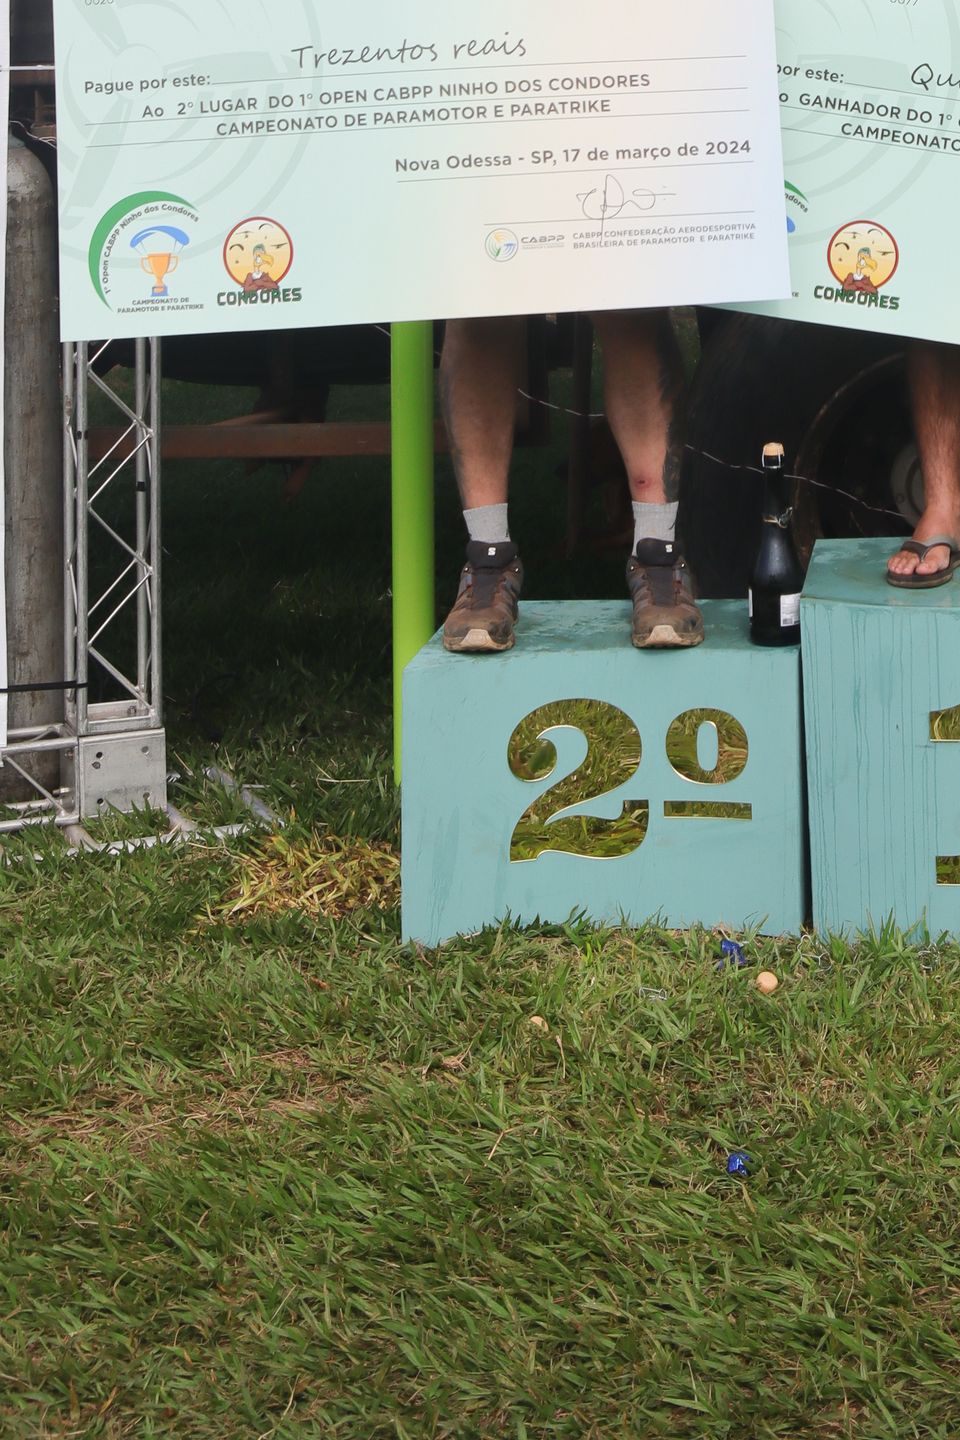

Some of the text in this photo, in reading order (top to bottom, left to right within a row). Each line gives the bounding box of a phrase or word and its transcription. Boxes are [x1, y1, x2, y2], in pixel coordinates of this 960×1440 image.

[289, 31, 528, 69] Trezentos reais
[84, 73, 211, 95] Pague por este:
[804, 67, 844, 83] este:
[141, 72, 650, 119] Ao 2º LUGAR DO 1º OPEN CABPP NINHO DOS CONDORES
[798, 92, 901, 119] GANHADOR
[905, 107, 933, 124] DO
[938, 112, 953, 126] 1º
[215, 98, 611, 136] CAMPEONATO DE PARAMOTOR E PARATRIKE
[394, 138, 751, 172] Nova Odessa SP, 17 de março de 2024
[603, 222, 757, 239] CONFEDERAÇÃO AERODESPORTIVA
[639, 231, 755, 246] PARAMOTOR PARATRIKE
[217, 287, 302, 308] CONDORES
[813, 284, 901, 312] CONDORES
